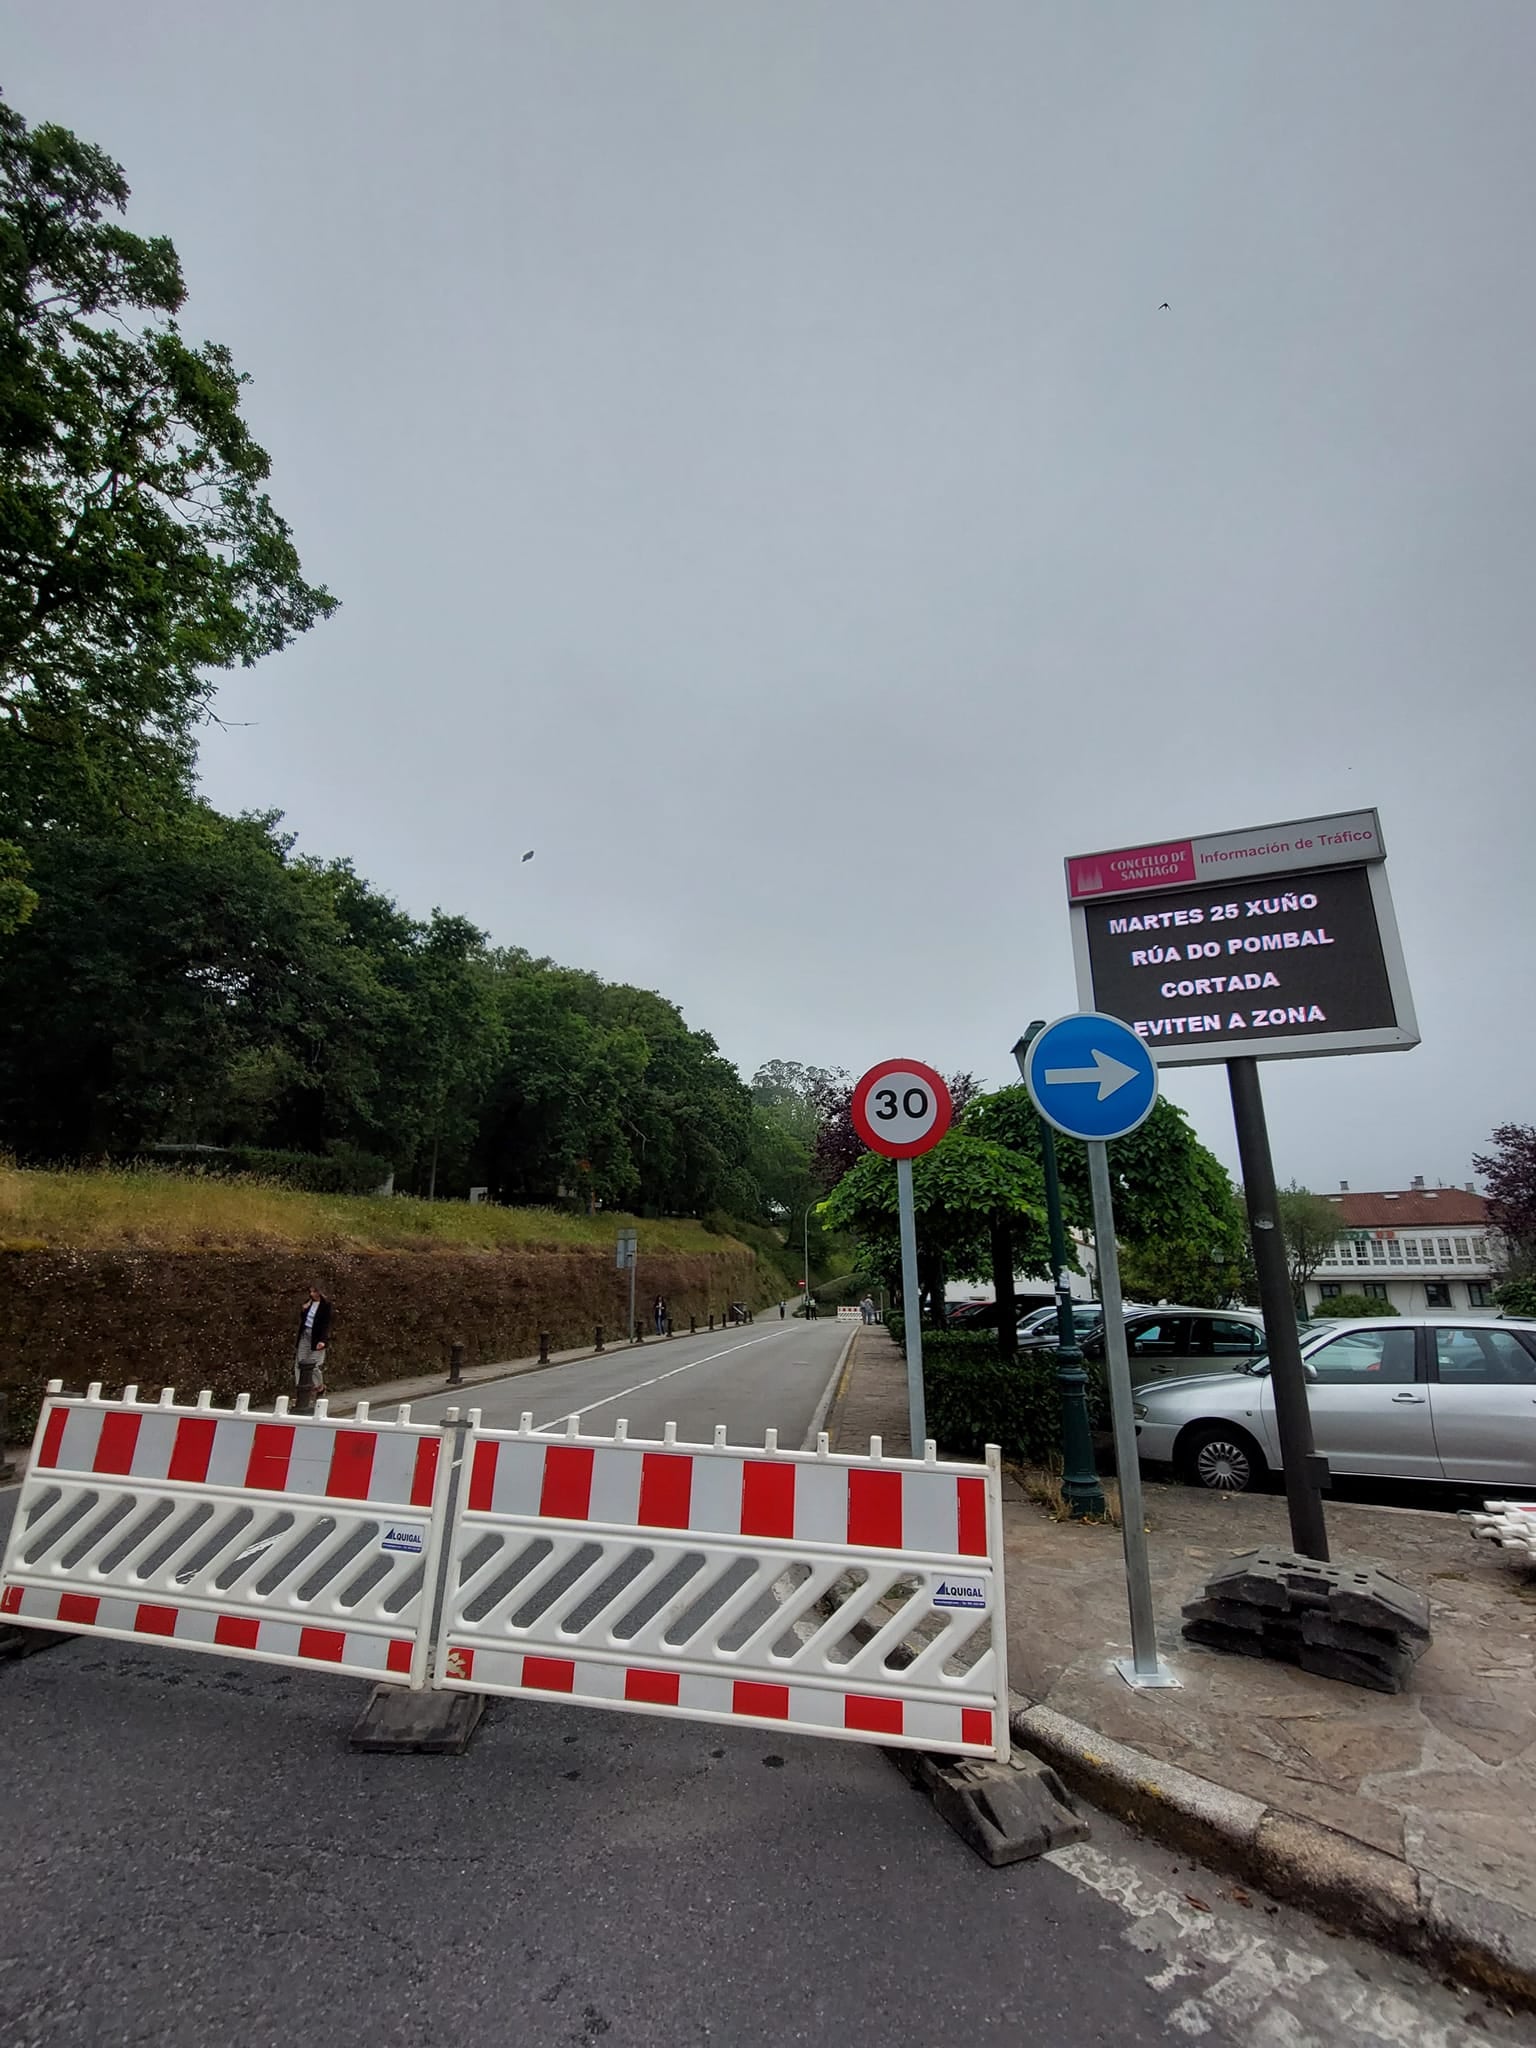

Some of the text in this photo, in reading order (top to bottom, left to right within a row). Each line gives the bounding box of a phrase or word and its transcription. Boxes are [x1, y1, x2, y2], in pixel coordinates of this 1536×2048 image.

[1110, 850, 1187, 872] CONCELLO DE
[1200, 828, 1373, 864] Información de Tráfico
[1121, 863, 1179, 882] SANTIAGO
[1109, 891, 1319, 935] MARTES 25 XUÑO
[1131, 928, 1335, 967] RÚA DO POMBAL
[1161, 972, 1280, 998] CORTADA
[1133, 1004, 1327, 1037] EVITEN A ZONA
[876, 1088, 928, 1120] 30
